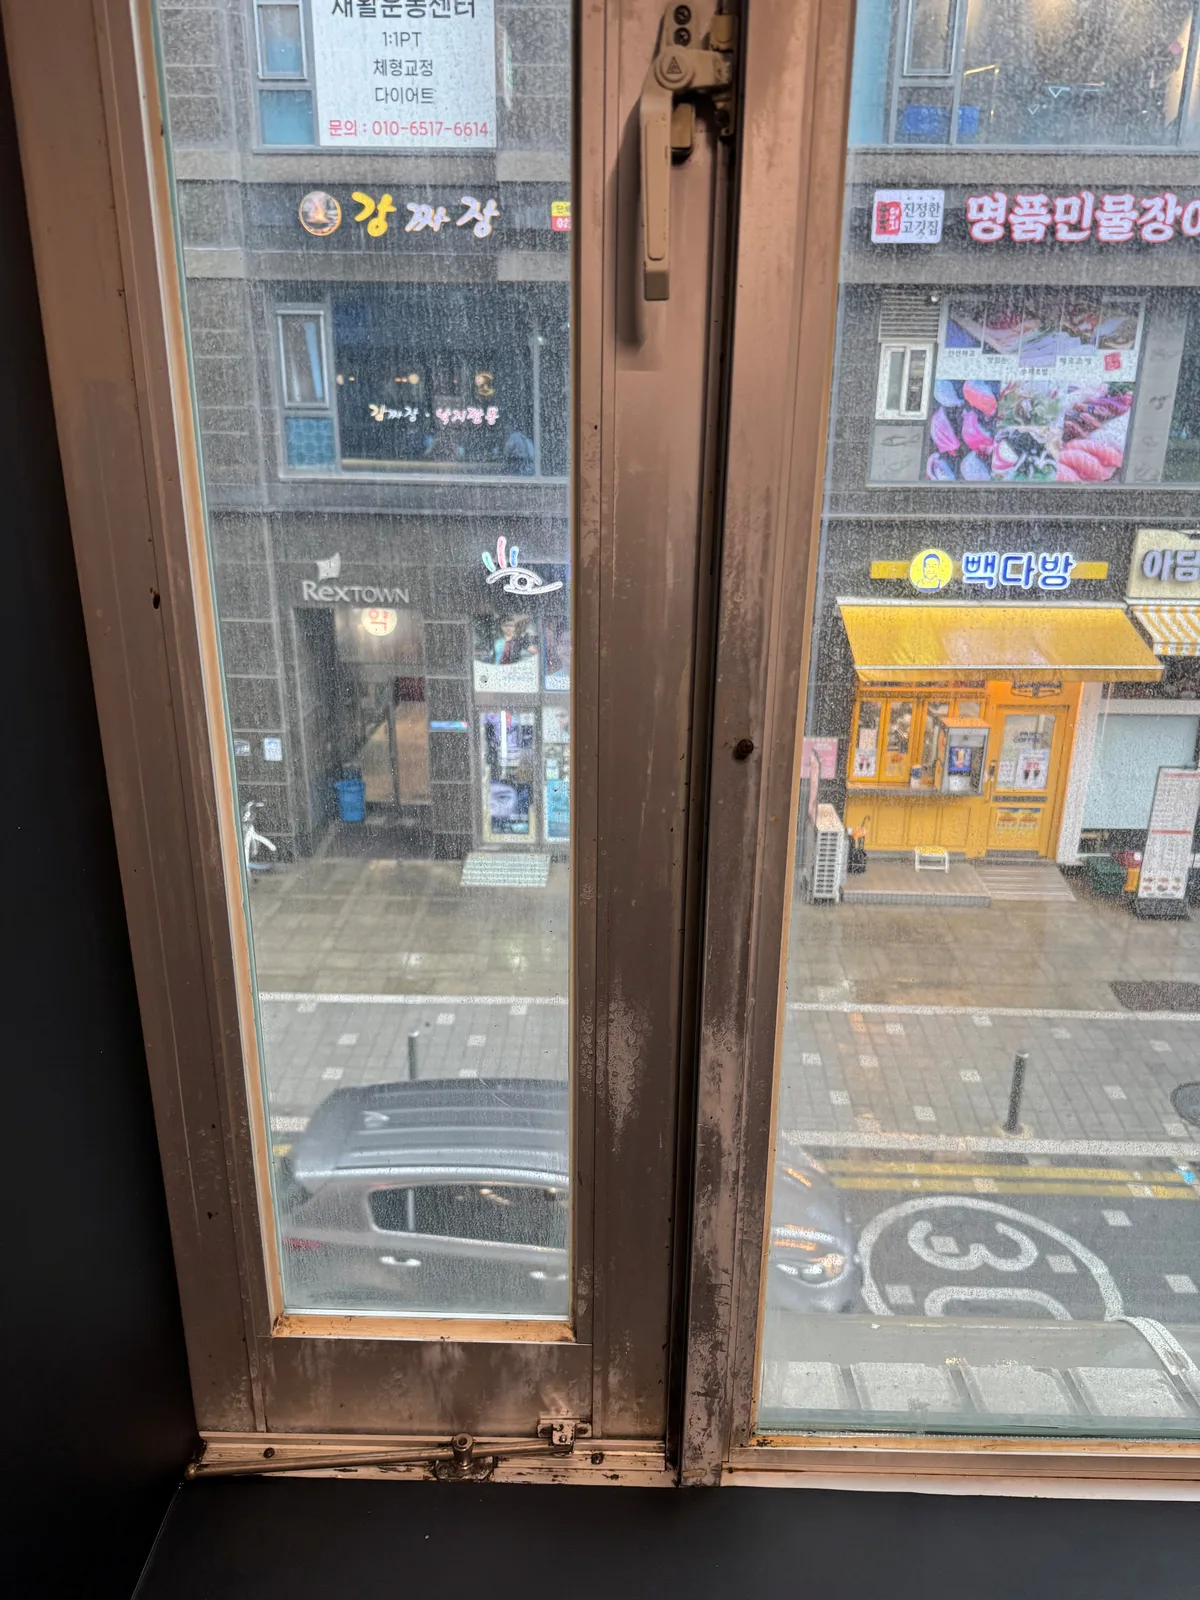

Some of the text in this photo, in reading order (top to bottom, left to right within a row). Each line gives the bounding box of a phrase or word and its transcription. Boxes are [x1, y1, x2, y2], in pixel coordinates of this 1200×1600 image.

[373, 58, 434, 77] 체형교정
[374, 86, 436, 104] 다이어트
[328, 119, 357, 137] 문의
[372, 121, 488, 137] 010-6517-6614
[903, 202, 941, 218] 진정한
[901, 220, 939, 236] 고깃집
[962, 551, 1077, 590] 빽다방
